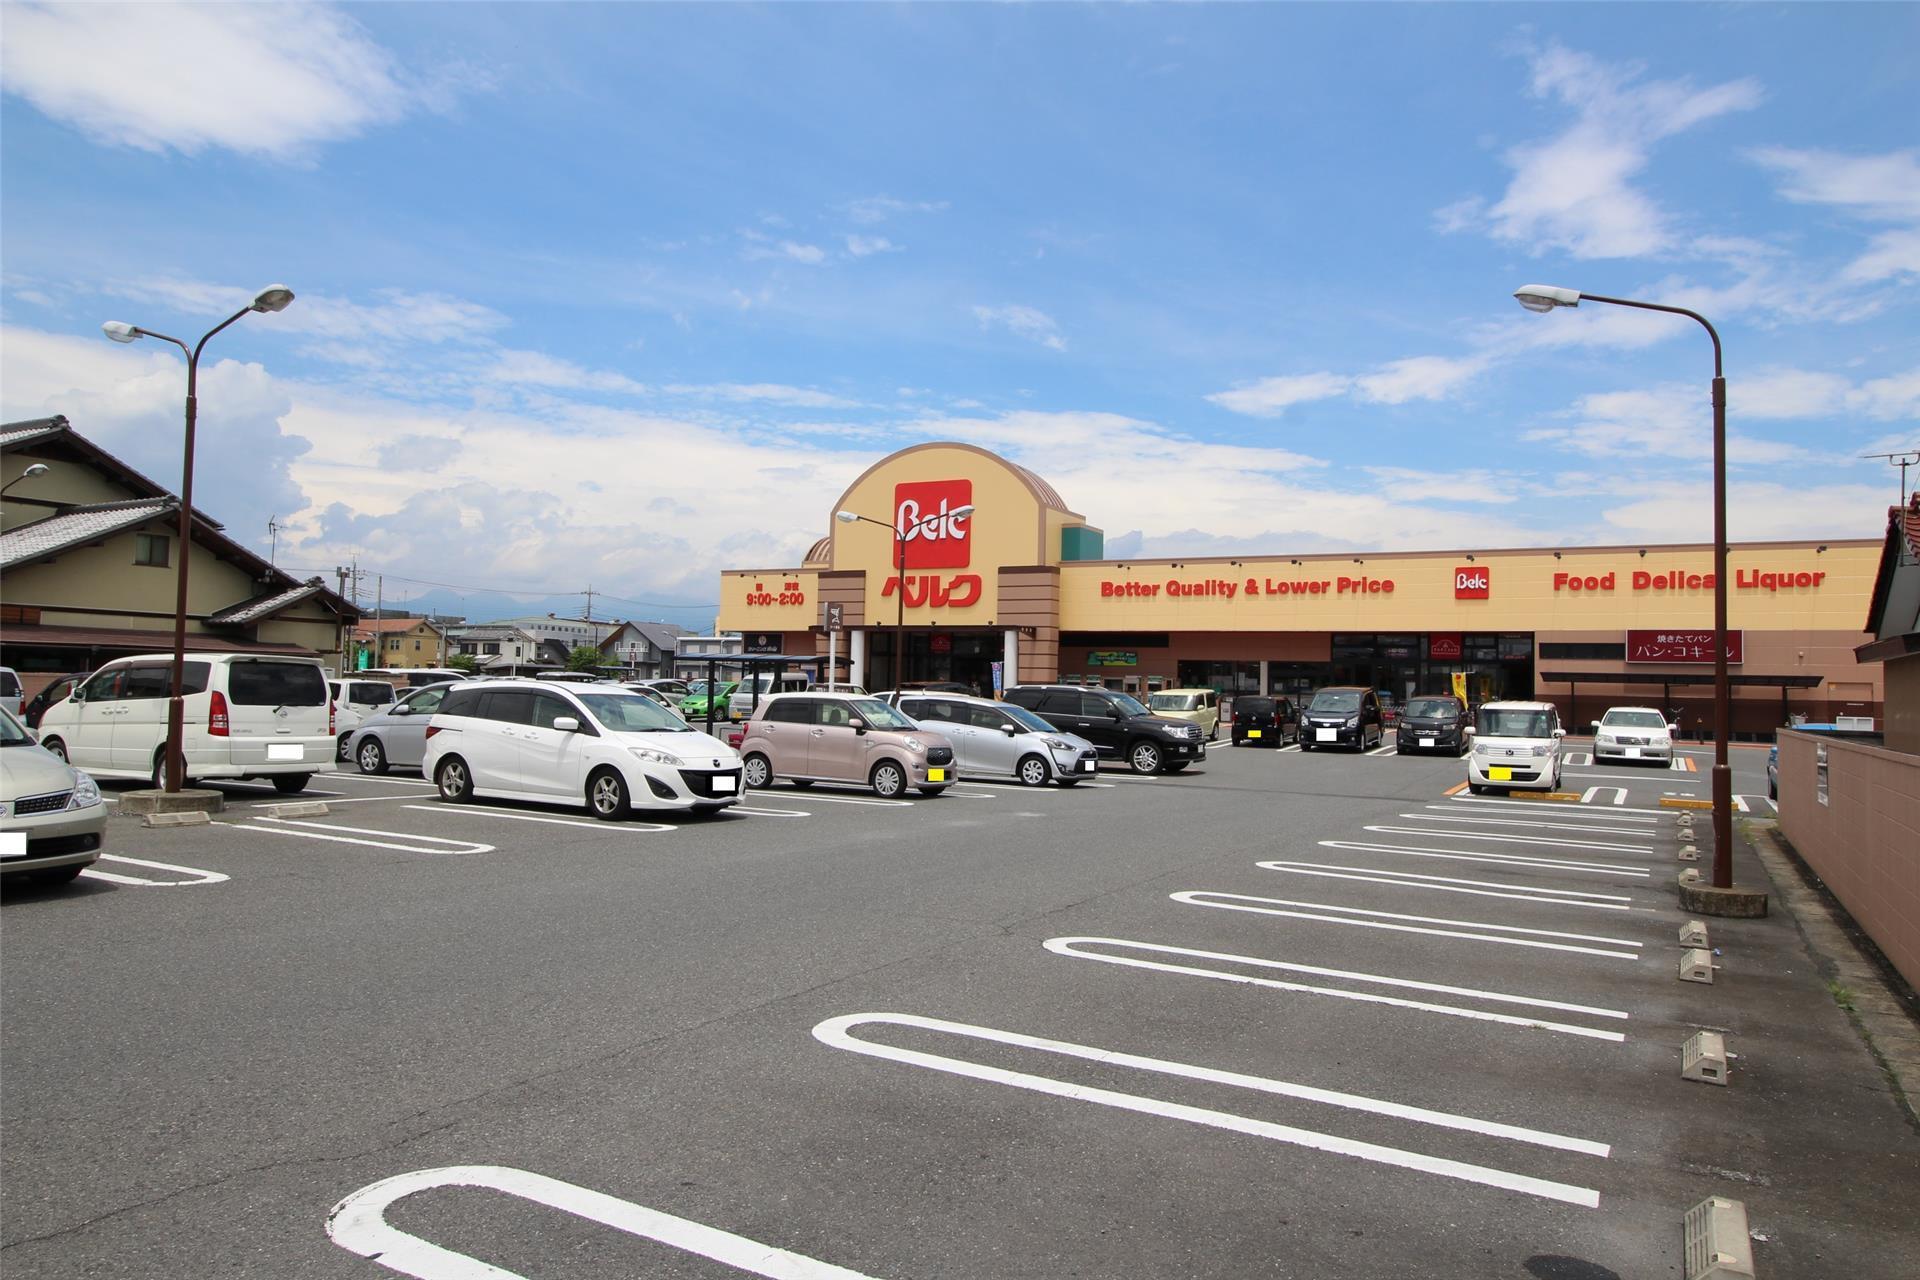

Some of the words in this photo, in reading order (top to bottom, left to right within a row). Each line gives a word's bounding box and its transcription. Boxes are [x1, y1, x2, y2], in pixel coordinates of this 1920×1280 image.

[896, 498, 967, 541] Belc
[881, 574, 983, 609] ベルク
[1102, 581, 1161, 597] Better
[1166, 580, 1237, 599] Quality
[1244, 579, 1259, 595] &
[1266, 577, 1331, 595] Lower
[1336, 576, 1395, 593] Price
[1457, 573, 1489, 590] Belc
[1554, 572, 1616, 592] Food
[1632, 571, 1716, 591] Delica
[1736, 569, 1825, 593] Liquor
[1656, 634, 1712, 644] 焼きたてパン
